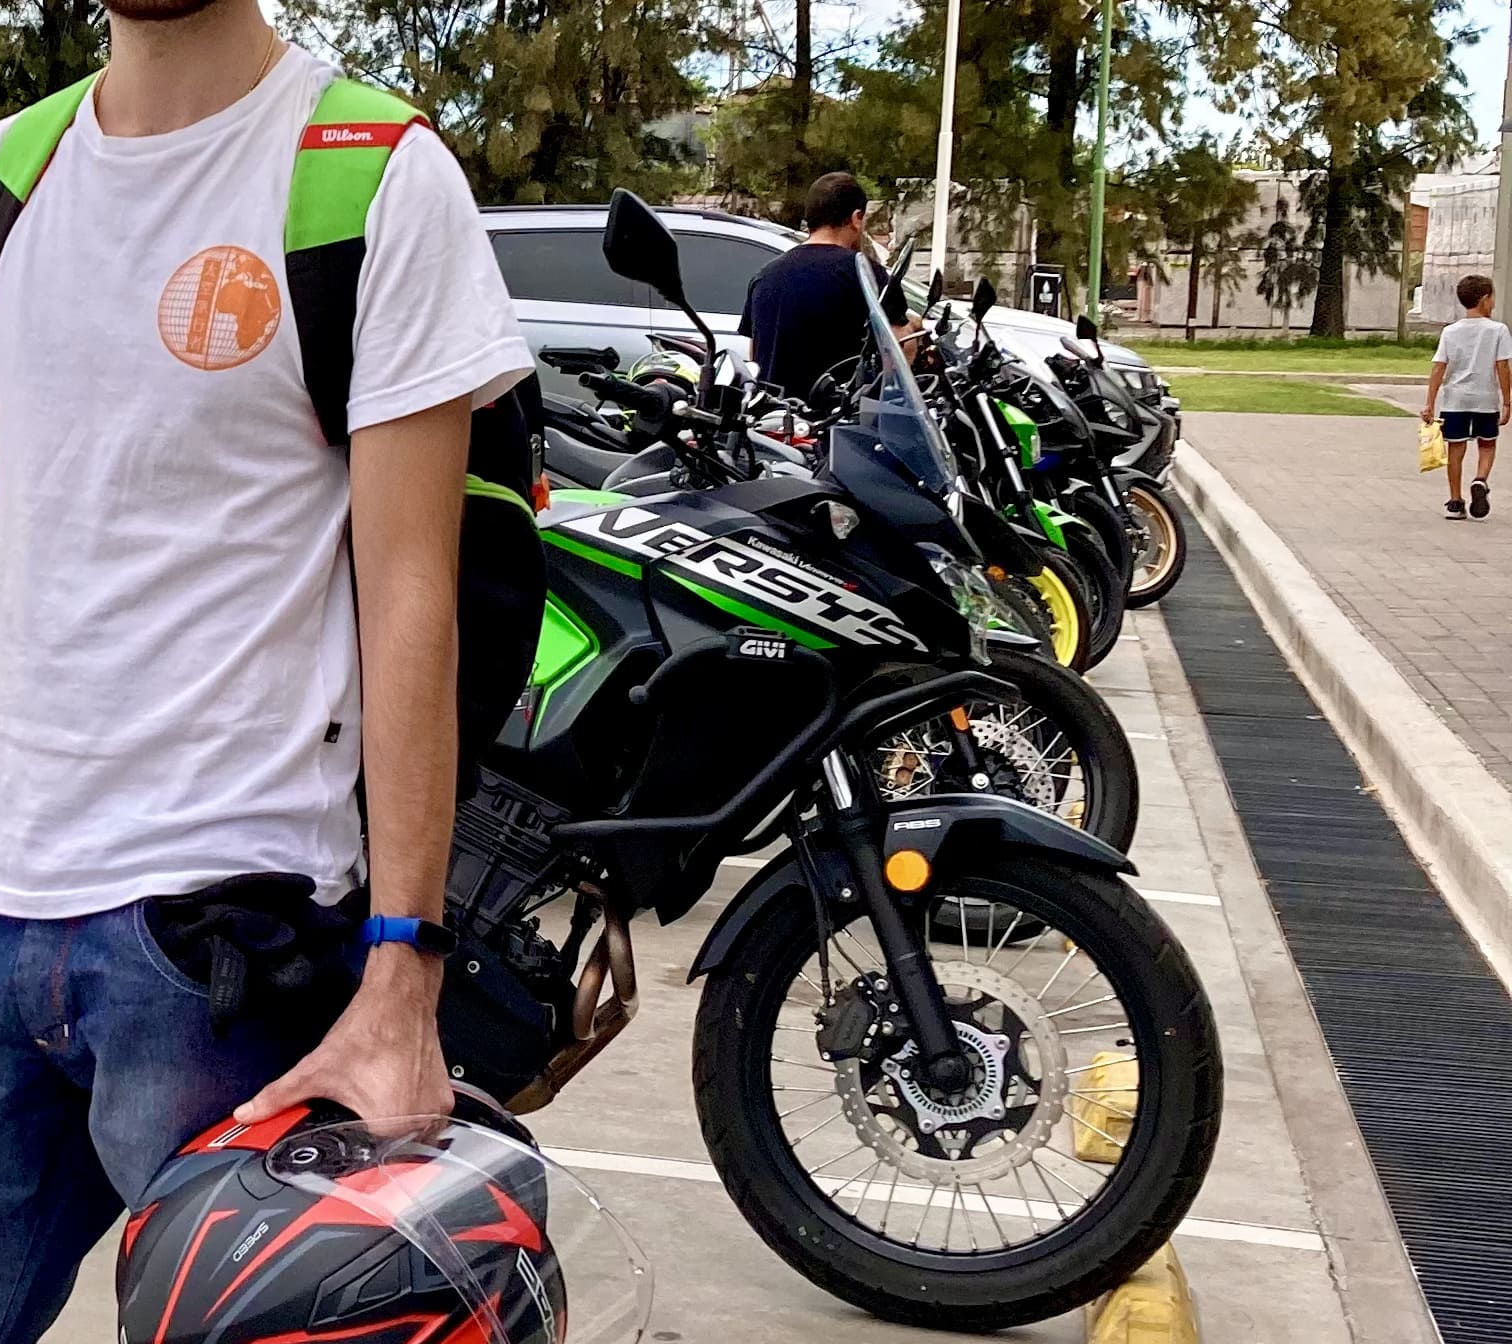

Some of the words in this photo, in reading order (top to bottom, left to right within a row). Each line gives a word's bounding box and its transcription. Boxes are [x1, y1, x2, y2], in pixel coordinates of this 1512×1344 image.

[321, 128, 374, 143] Wilson
[747, 536, 800, 565] Kawasaki
[597, 507, 929, 652] VERSYS
[739, 639, 786, 658] GIVI
[893, 818, 941, 831] ABS
[232, 1221, 270, 1262] SPEED
